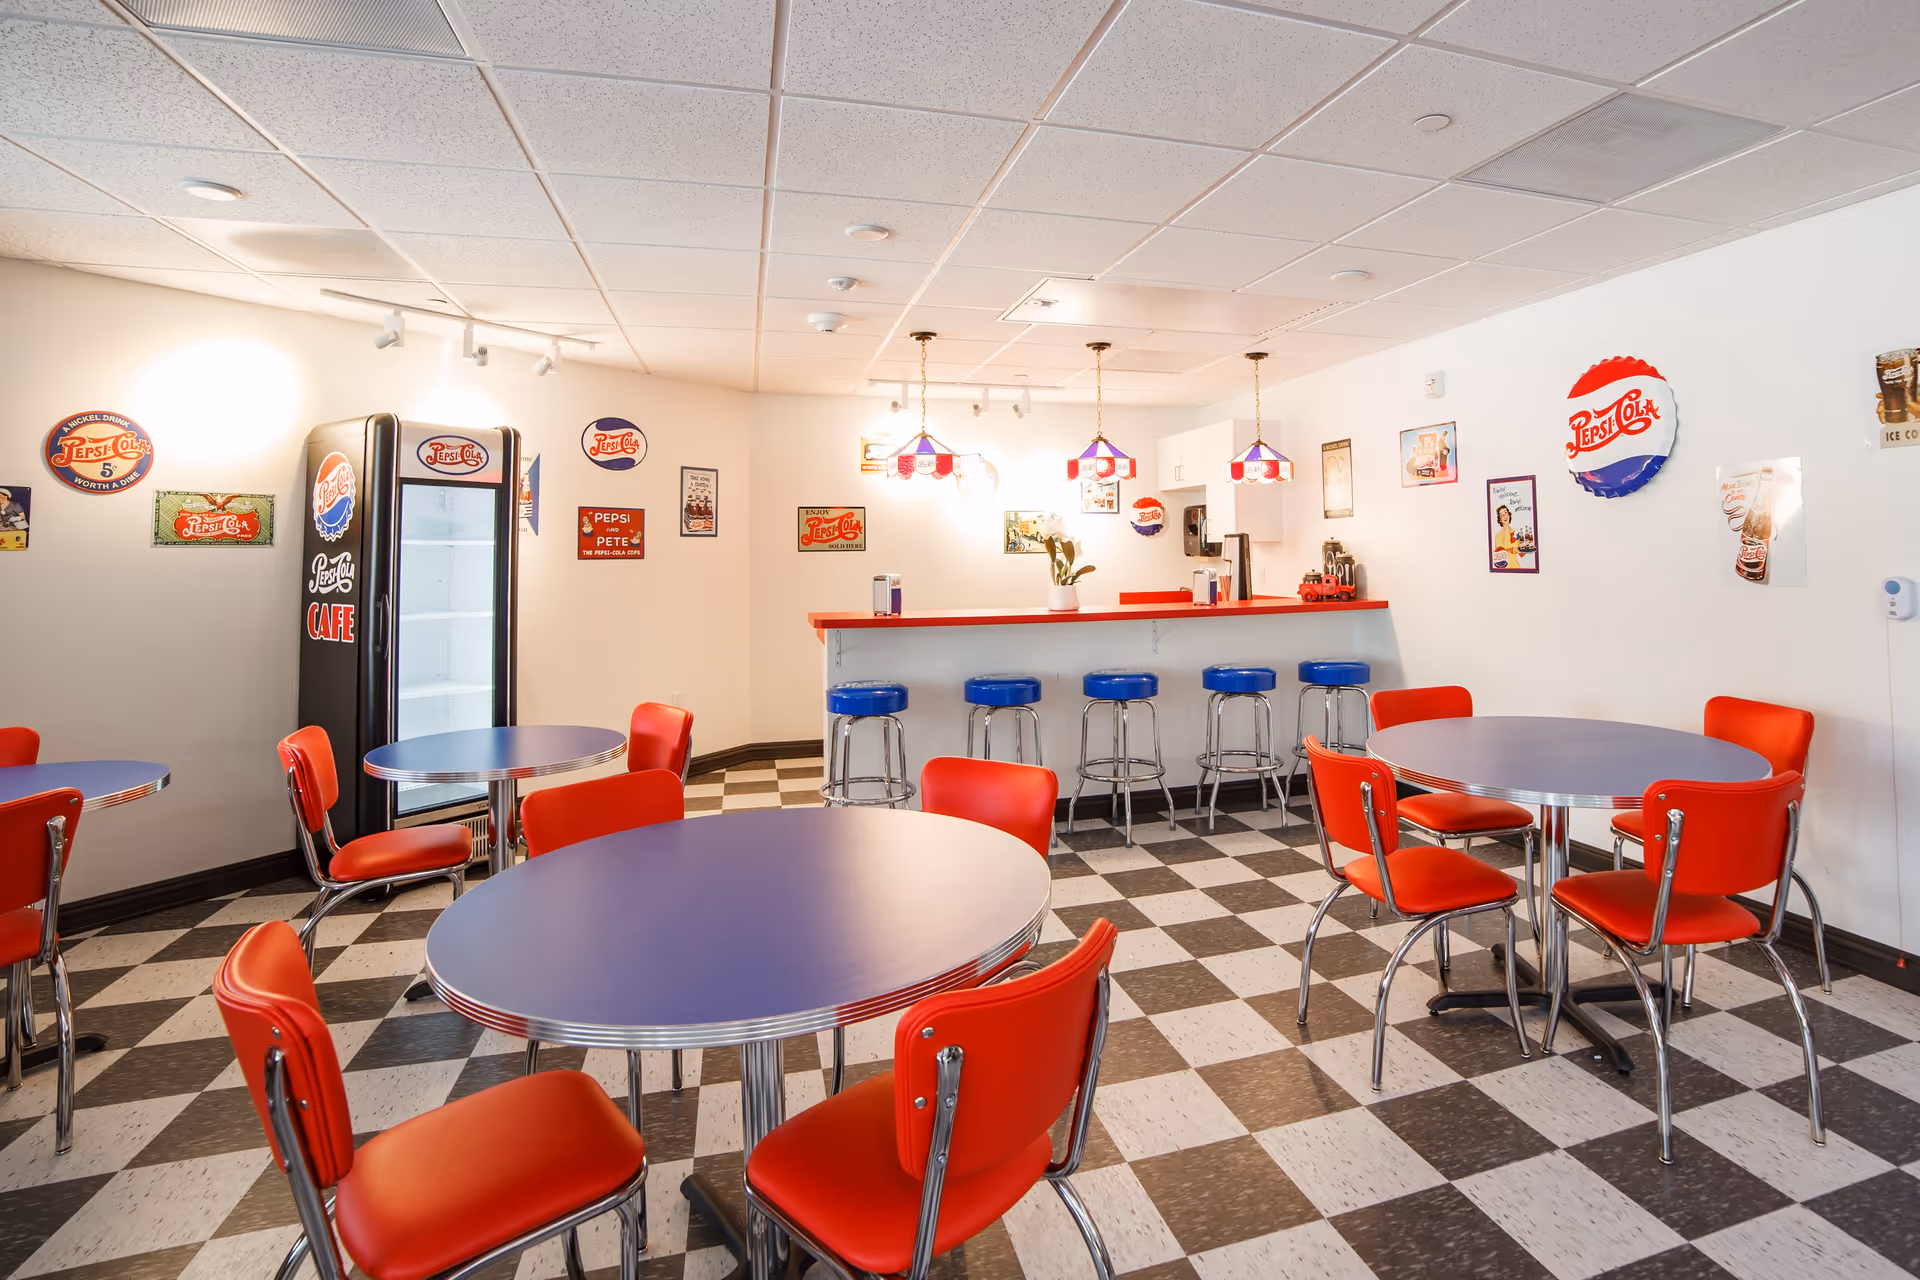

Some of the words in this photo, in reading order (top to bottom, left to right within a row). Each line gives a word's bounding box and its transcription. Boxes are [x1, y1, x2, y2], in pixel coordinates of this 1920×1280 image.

[68, 415, 100, 428] NICKEL
[103, 415, 131, 428] DRINK
[1886, 430, 1900, 441] ICE
[74, 476, 109, 489] WORTH
[120, 471, 140, 486] DIME
[594, 512, 630, 524] PEPSI
[596, 536, 629, 547] PETE
[307, 602, 354, 643] CAFE
